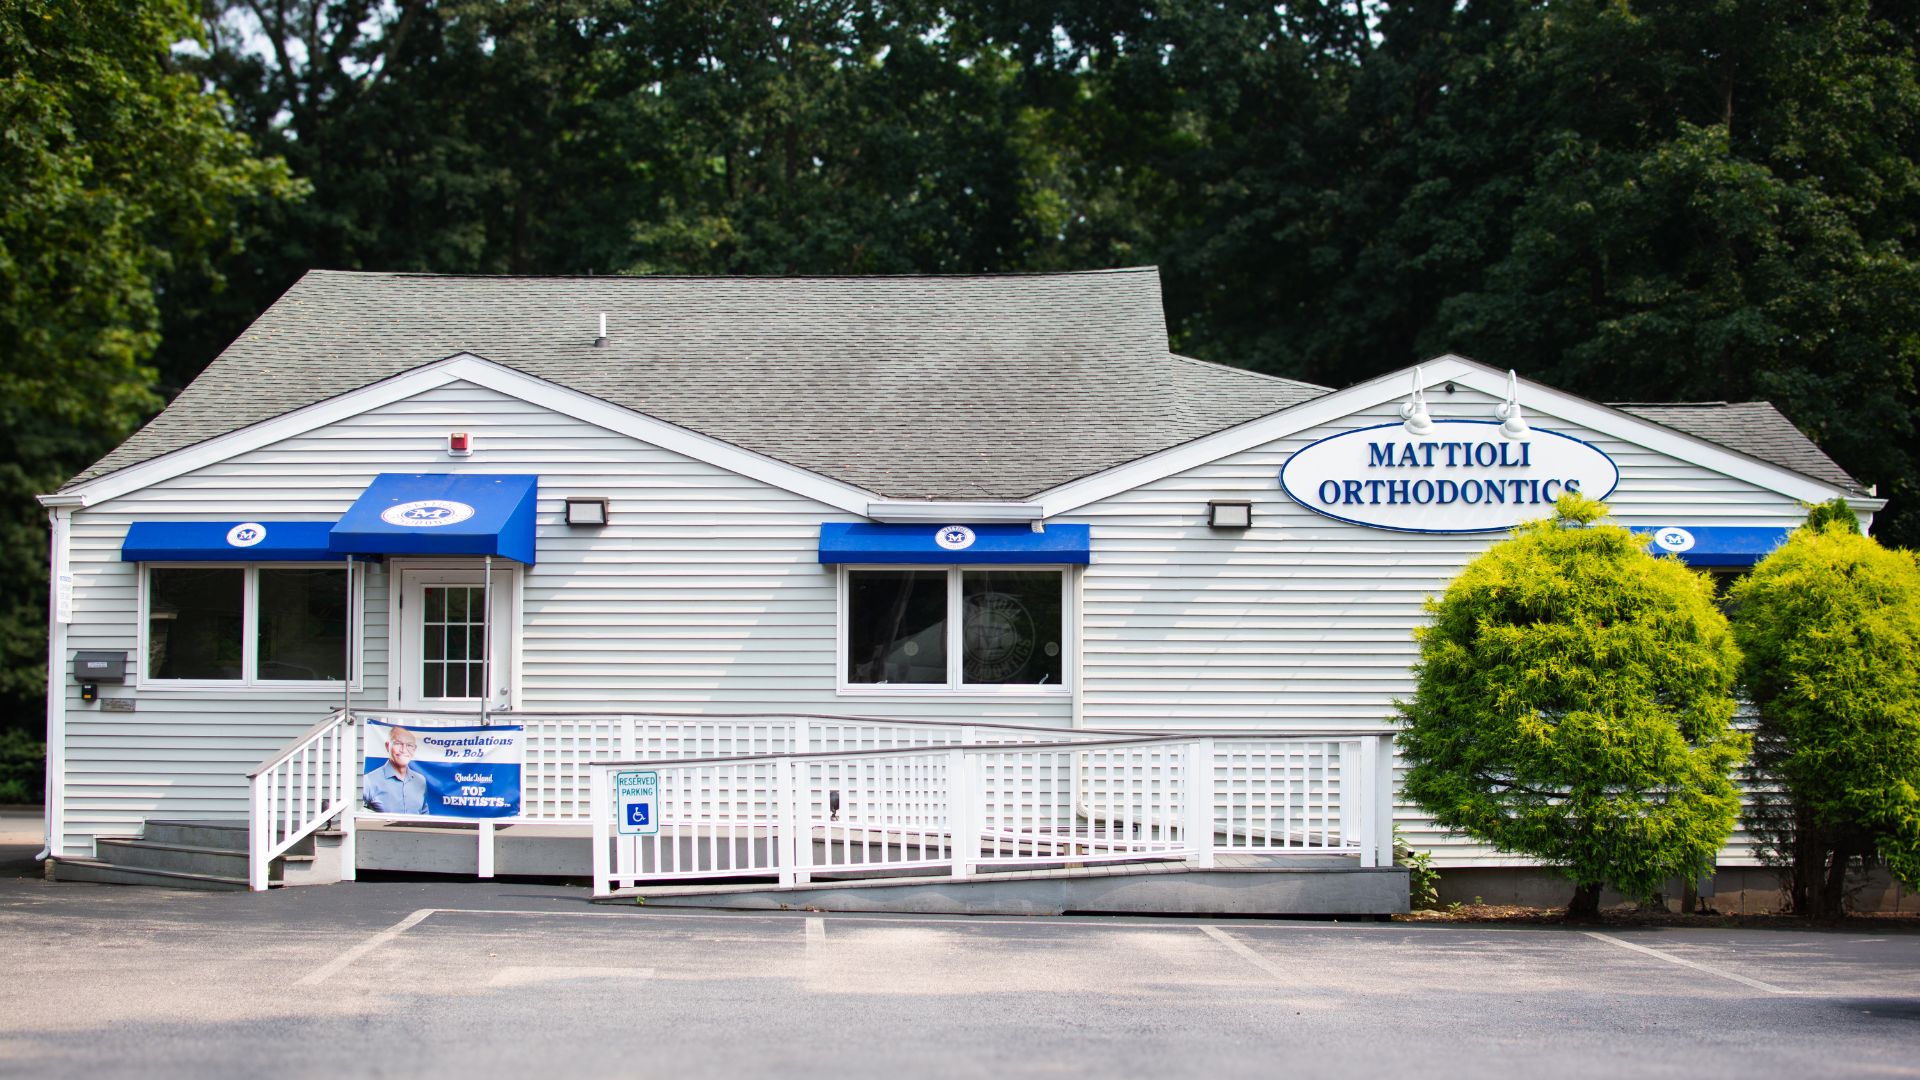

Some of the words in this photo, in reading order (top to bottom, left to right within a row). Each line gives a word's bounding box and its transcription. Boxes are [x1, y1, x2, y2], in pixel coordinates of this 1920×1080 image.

[1367, 442, 1531, 467] MATTIOLI
[1318, 479, 1581, 505] ORTHODONTICS
[423, 736, 514, 748] Congratulations
[445, 749, 460, 758] Dr.
[462, 749, 484, 758] Bob
[619, 777, 656, 785] RESERVED
[461, 786, 486, 796] TOP
[622, 788, 653, 796] PARKING
[443, 796, 504, 807] DENTISTS
